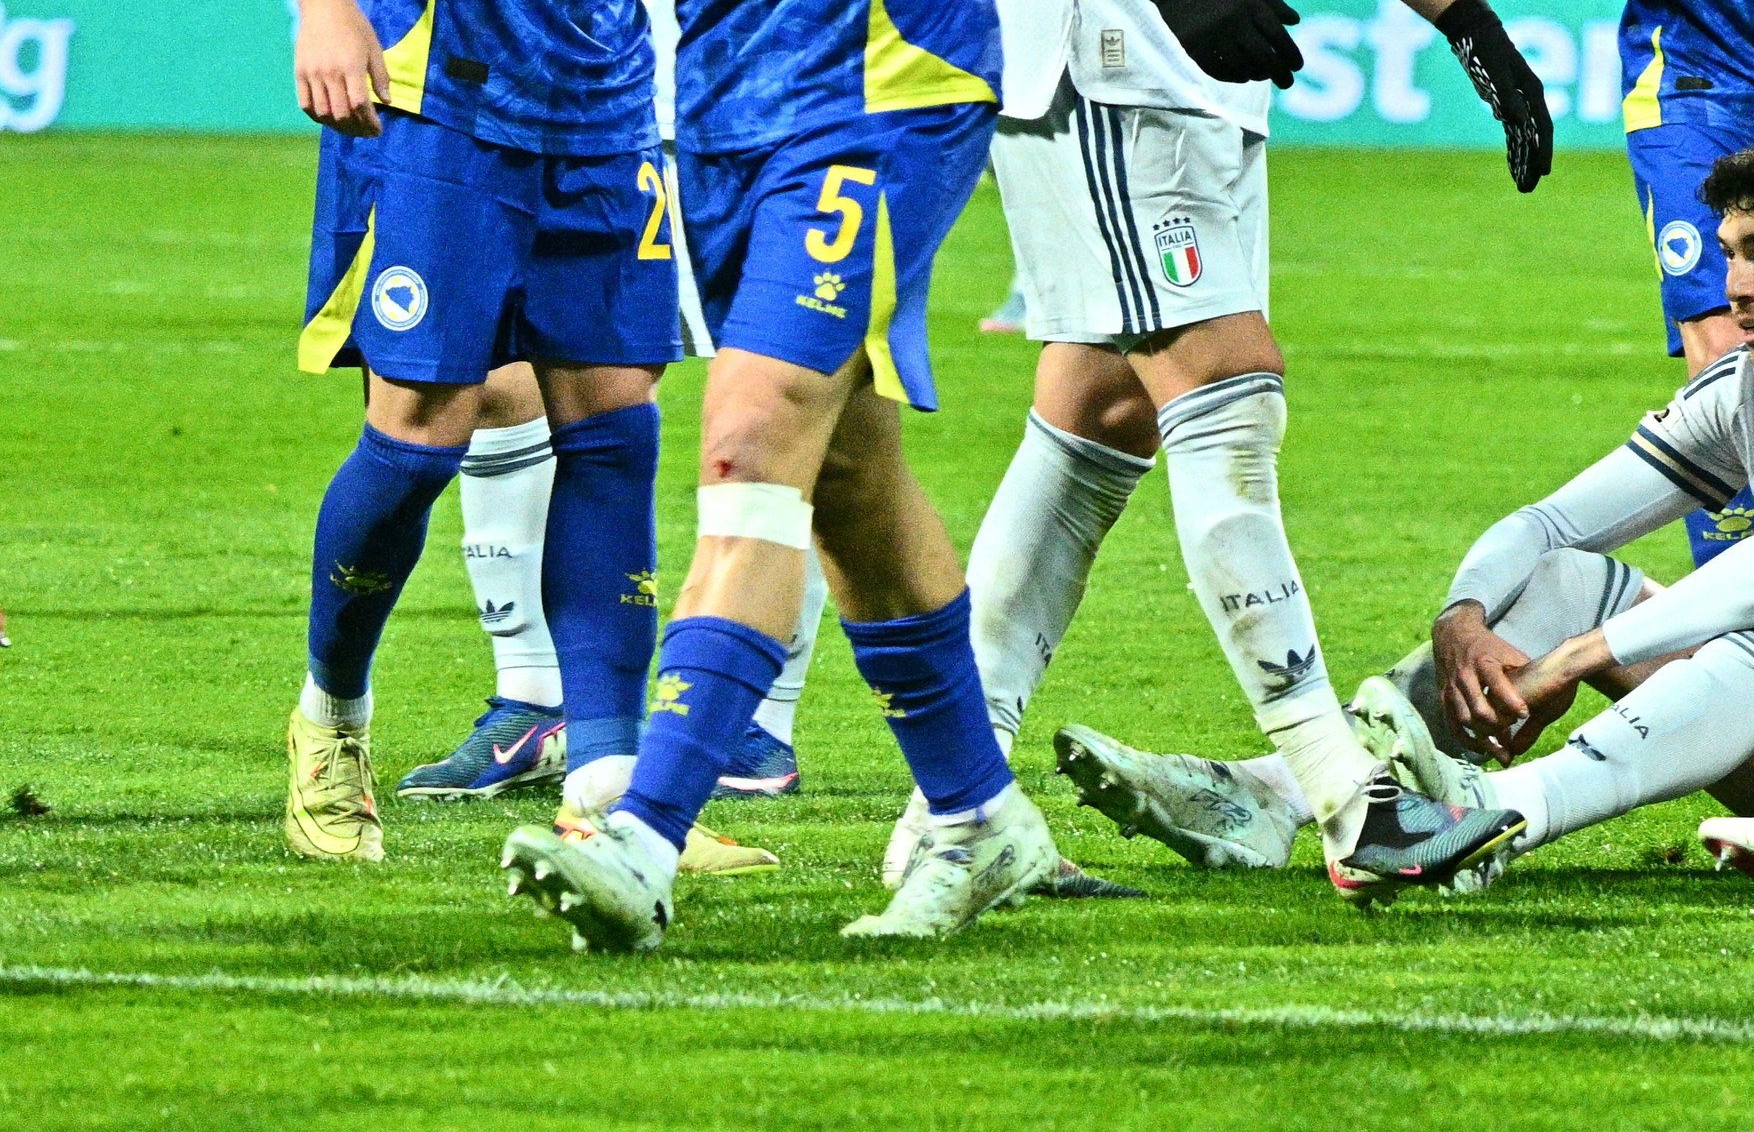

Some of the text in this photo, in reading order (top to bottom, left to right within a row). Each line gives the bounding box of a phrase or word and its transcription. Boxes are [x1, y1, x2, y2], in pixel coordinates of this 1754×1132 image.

[637, 161, 677, 260] 2
[804, 164, 877, 263] 5
[1158, 230, 1193, 248] ITALIA
[1220, 580, 1300, 613] ITALIA
